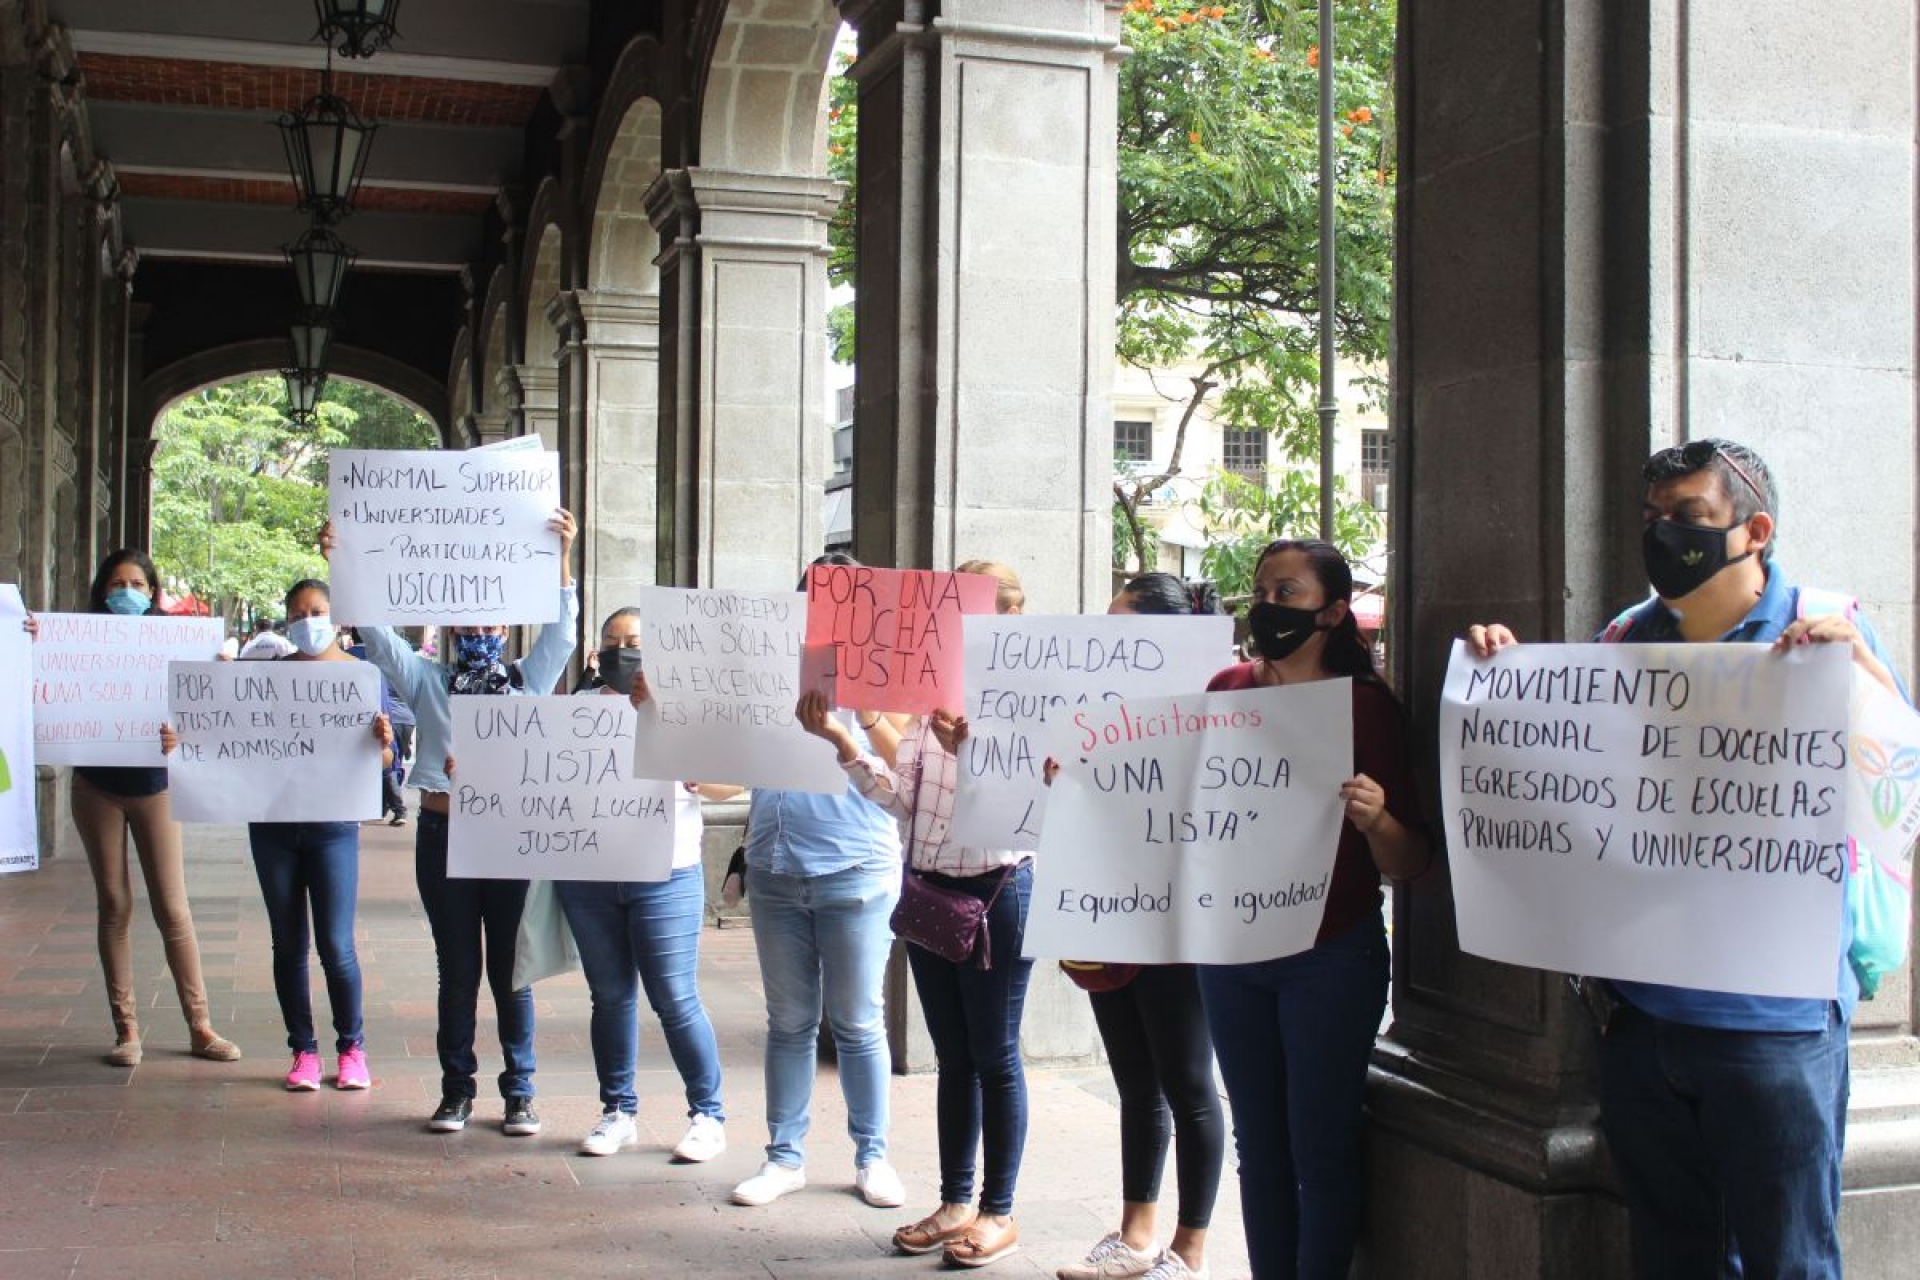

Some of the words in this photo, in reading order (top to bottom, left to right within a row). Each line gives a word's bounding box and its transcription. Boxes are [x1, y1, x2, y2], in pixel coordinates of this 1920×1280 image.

[350, 461, 446, 490] NORMAL
[459, 462, 552, 494] SUPERIOR
[354, 502, 505, 525] UNIVERSIDADES
[391, 535, 533, 564] PARTICULARES
[388, 573, 505, 606] USICAMM
[808, 566, 878, 605] POR
[899, 572, 962, 611] UNA
[720, 622, 777, 656] SOLA
[832, 608, 941, 651] LUCHA
[823, 648, 938, 688] JUSTA
[986, 631, 1164, 673] IGUALDAD
[176, 674, 213, 701] POR
[235, 676, 278, 702] UNA
[292, 678, 362, 704] LUCHA
[656, 664, 682, 689] LA
[1465, 665, 1690, 711] MOVIMIENTO
[176, 711, 235, 733] JUSTA
[251, 712, 275, 728] EN
[291, 712, 311, 729] EL
[474, 705, 545, 740] UNA
[572, 707, 633, 739] SOL
[661, 701, 687, 725] ES
[1074, 703, 1262, 752] Solicitamos
[115, 721, 127, 741] Y
[181, 742, 205, 762] DE
[217, 732, 315, 761] ADMISIÓN
[1461, 707, 1605, 754] NACIONAL
[1641, 724, 1681, 759] DE
[1698, 726, 1847, 770] DOCENTES
[520, 747, 620, 787] LISTA
[970, 732, 1036, 780] UNA
[1200, 756, 1292, 790] SOLA
[459, 784, 506, 818] POR
[521, 796, 574, 822] UNA
[592, 795, 667, 824] LUCHA
[1459, 765, 1617, 809] EGRESADOS
[1636, 777, 1676, 814] DE
[1691, 776, 1836, 819] ESCUELAS
[517, 828, 600, 856] JUSTA
[1458, 807, 1573, 854] PRIVADAS
[1595, 823, 1614, 861] Y
[1631, 829, 1847, 884] UNIVERSIDADES
[1057, 882, 1172, 923] Equidad
[1198, 891, 1214, 908] e
[1233, 872, 1329, 924] igualdad
